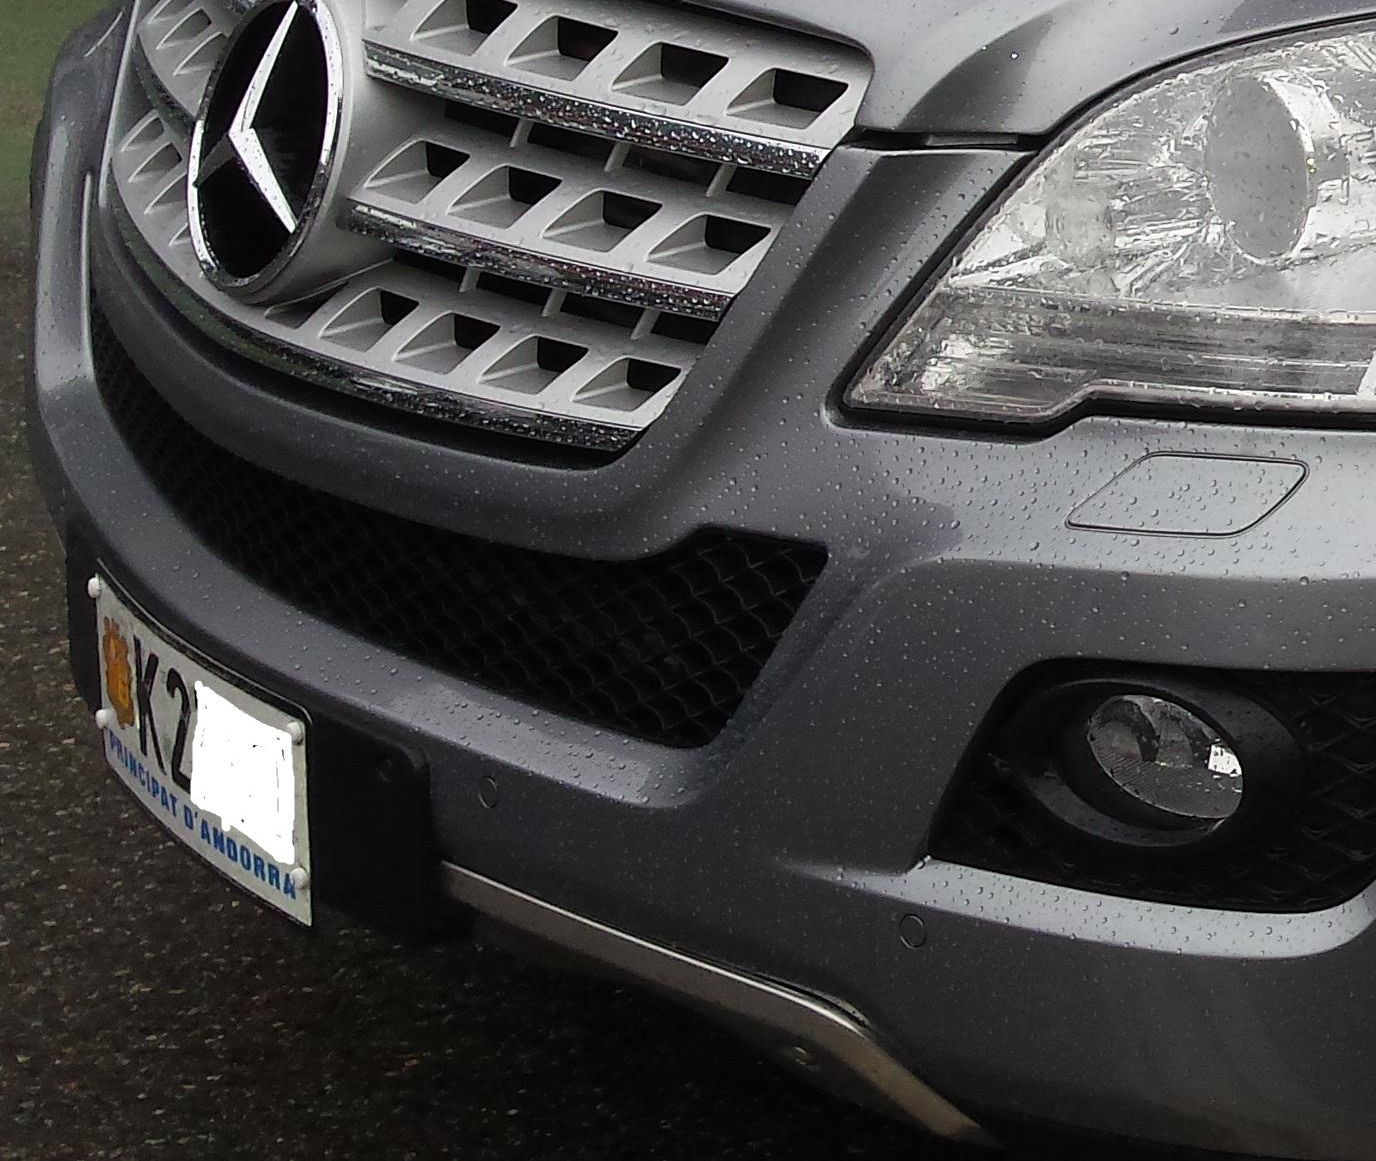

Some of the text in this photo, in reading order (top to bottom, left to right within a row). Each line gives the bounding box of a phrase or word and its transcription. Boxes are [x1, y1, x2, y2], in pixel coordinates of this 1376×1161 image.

[134, 635, 198, 795] K2
[108, 729, 297, 900] PRINCIPAT D'ANDORRA
